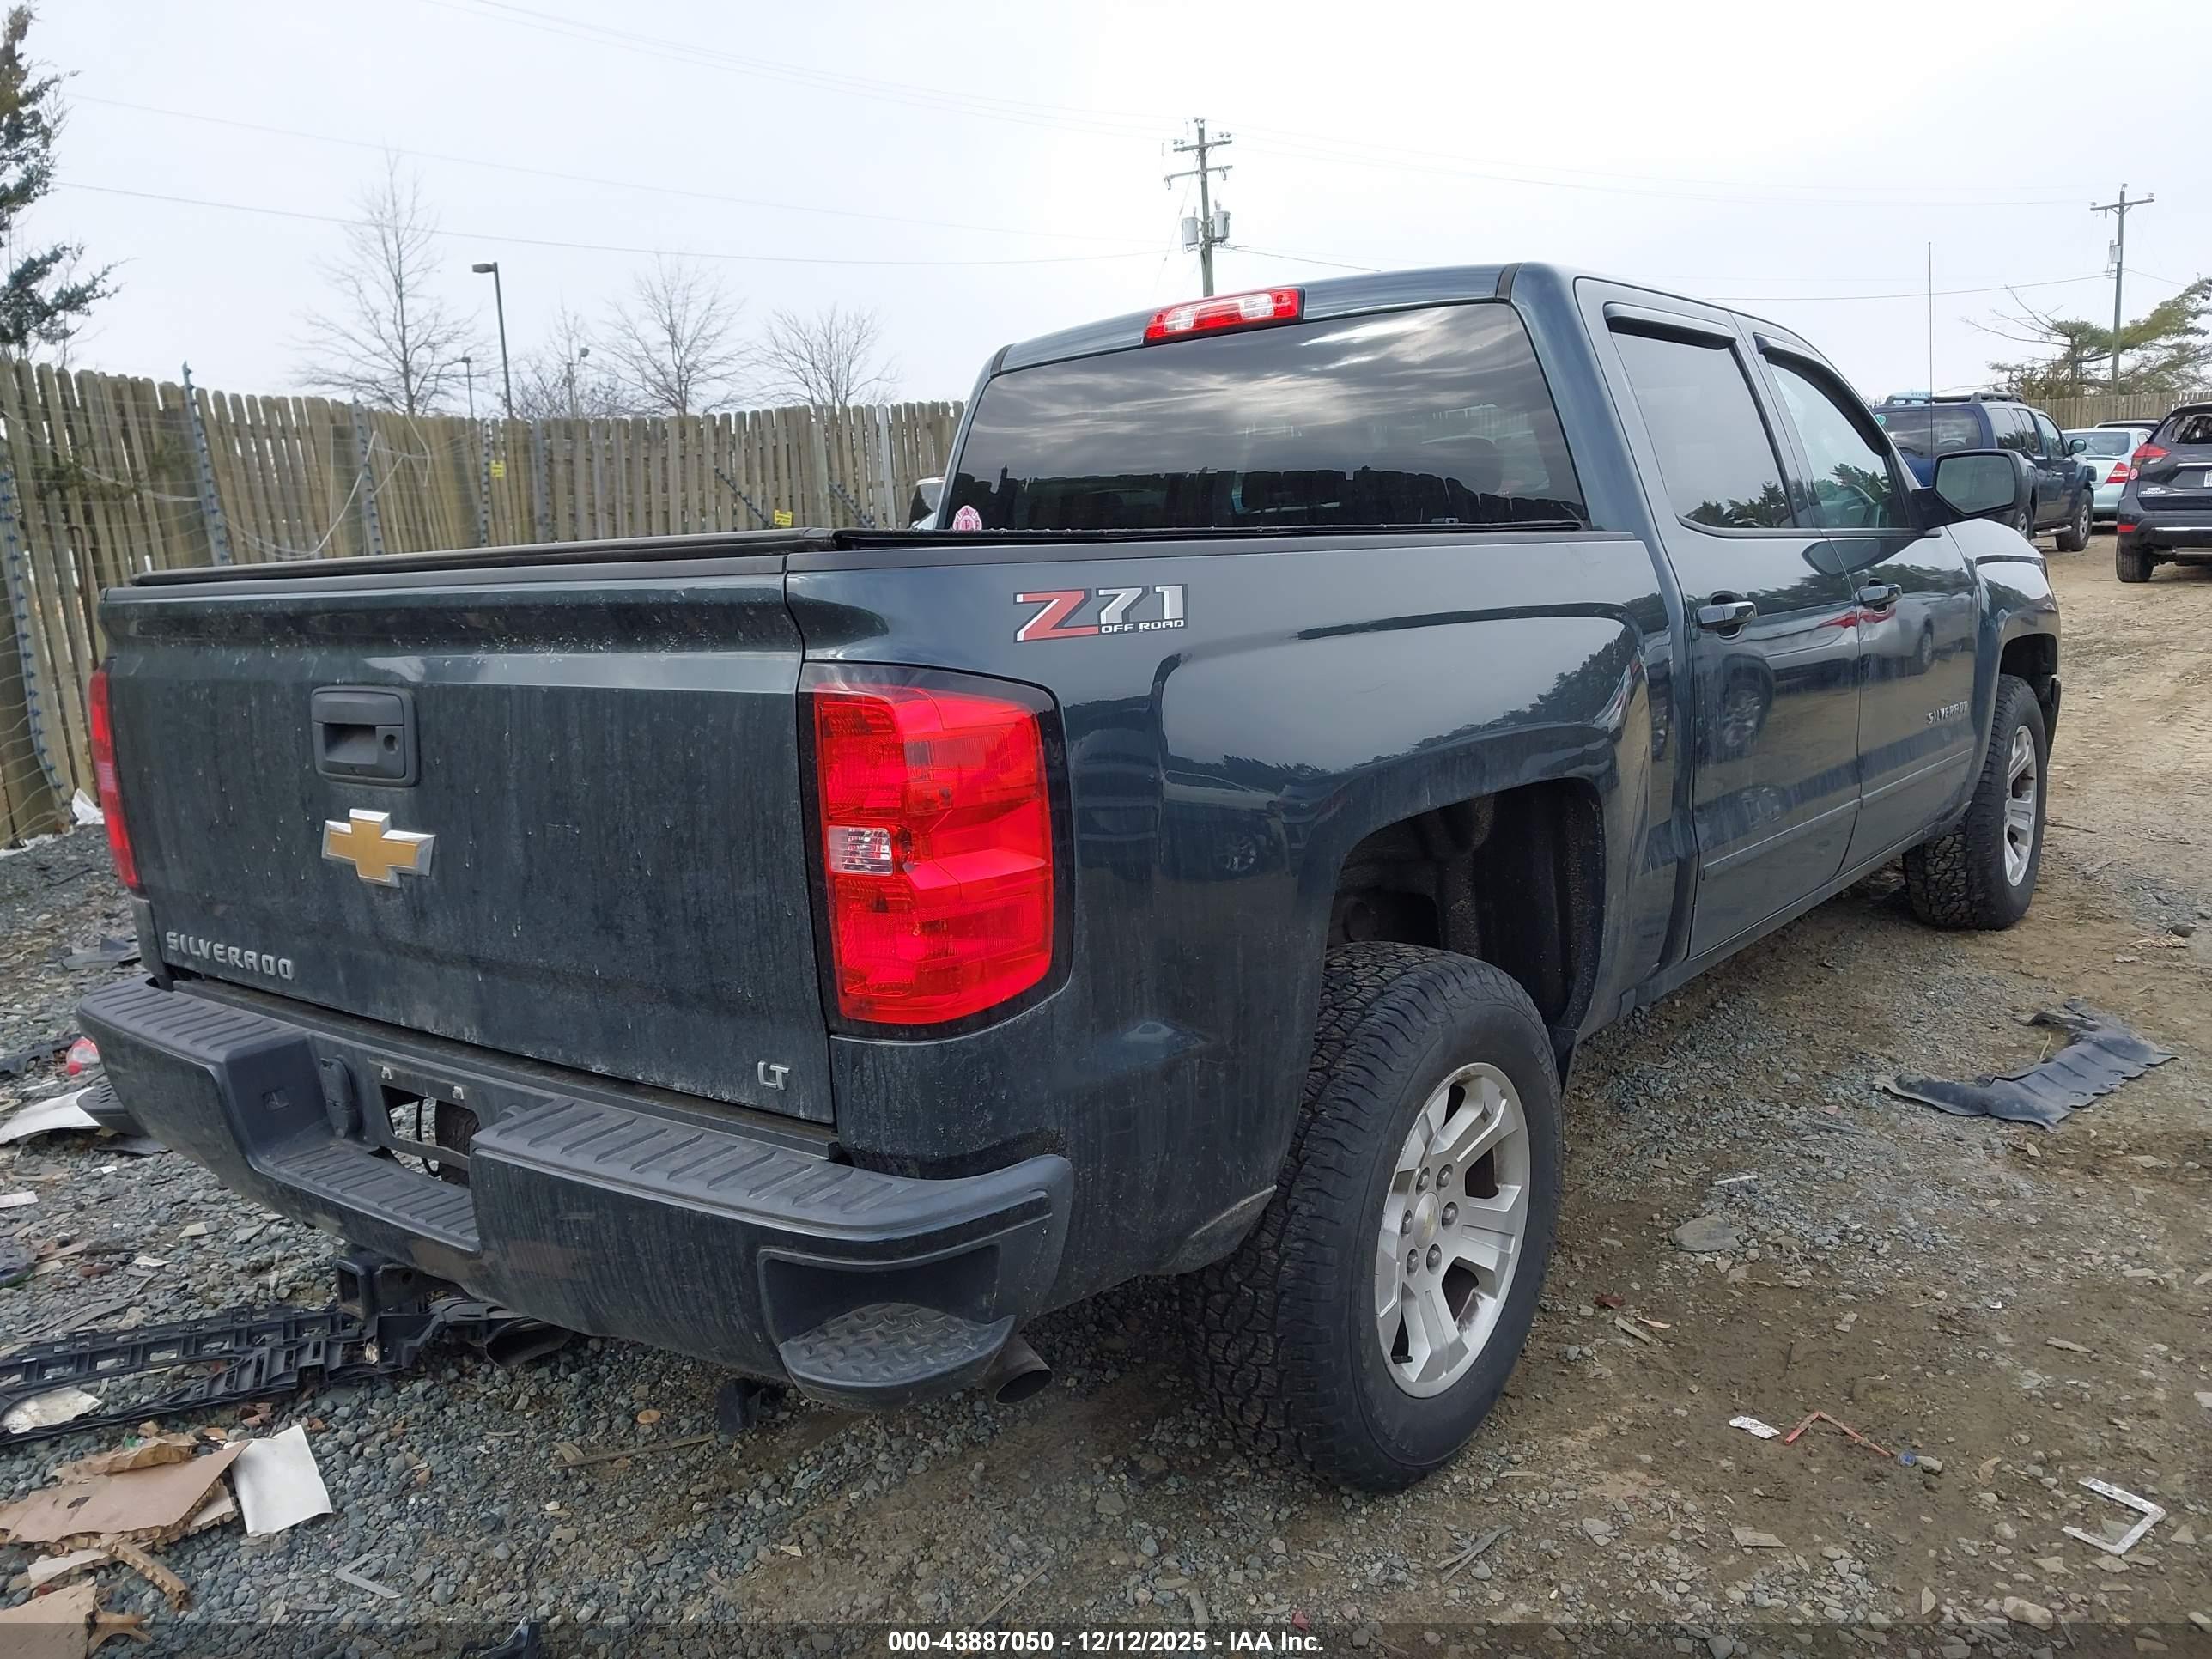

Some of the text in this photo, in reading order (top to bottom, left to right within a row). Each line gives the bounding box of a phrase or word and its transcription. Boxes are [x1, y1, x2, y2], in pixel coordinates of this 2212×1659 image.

[1014, 584, 1188, 642] Z71
[1101, 619, 1185, 634] OFF ROAD
[1928, 700, 1968, 725] SILVERADO
[166, 931, 294, 980] SILVERADO
[757, 1060, 790, 1091] LT
